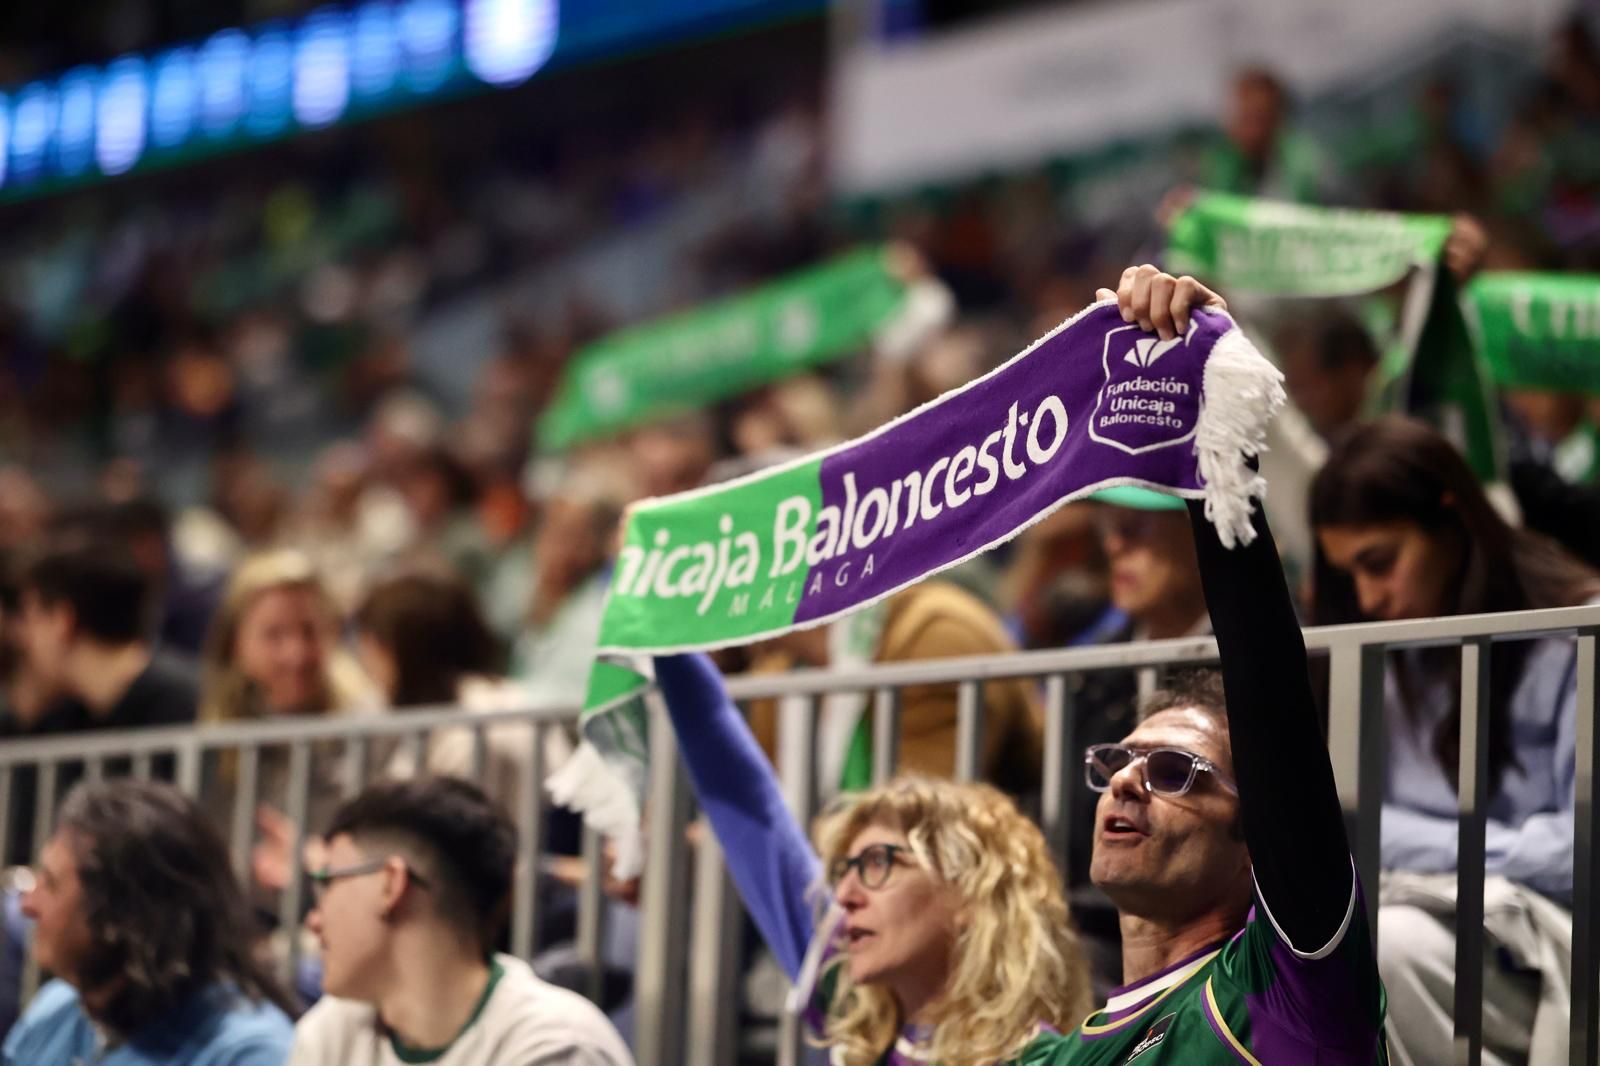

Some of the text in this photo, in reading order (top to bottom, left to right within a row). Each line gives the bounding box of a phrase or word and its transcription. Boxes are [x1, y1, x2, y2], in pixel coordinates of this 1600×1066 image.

[1106, 376, 1190, 399] Fundación
[1109, 395, 1176, 416] Unicaja
[1099, 412, 1183, 429] Baloncesto
[615, 394, 1069, 616] nicaja Baloncesto
